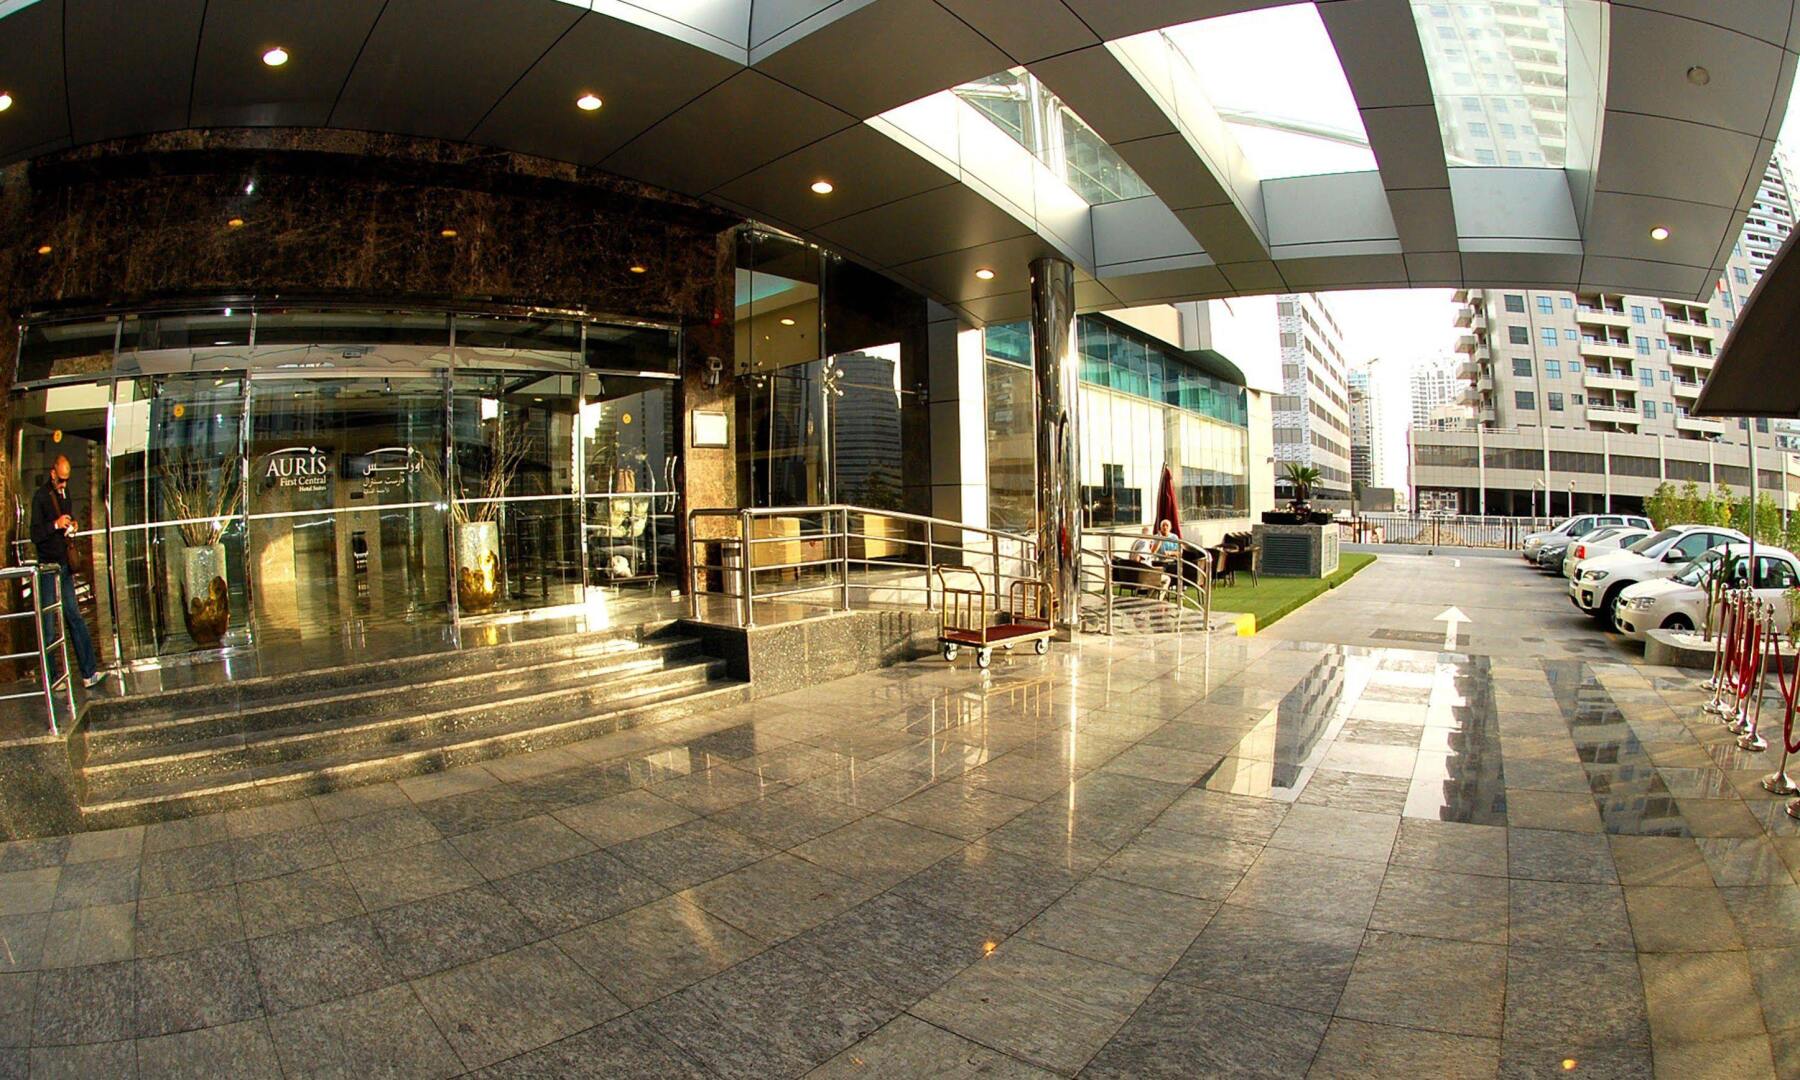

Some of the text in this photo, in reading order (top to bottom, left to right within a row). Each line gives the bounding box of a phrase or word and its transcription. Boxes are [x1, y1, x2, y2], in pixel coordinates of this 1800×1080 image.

[265, 456, 327, 477] AURIS
[280, 475, 326, 487] First Central
